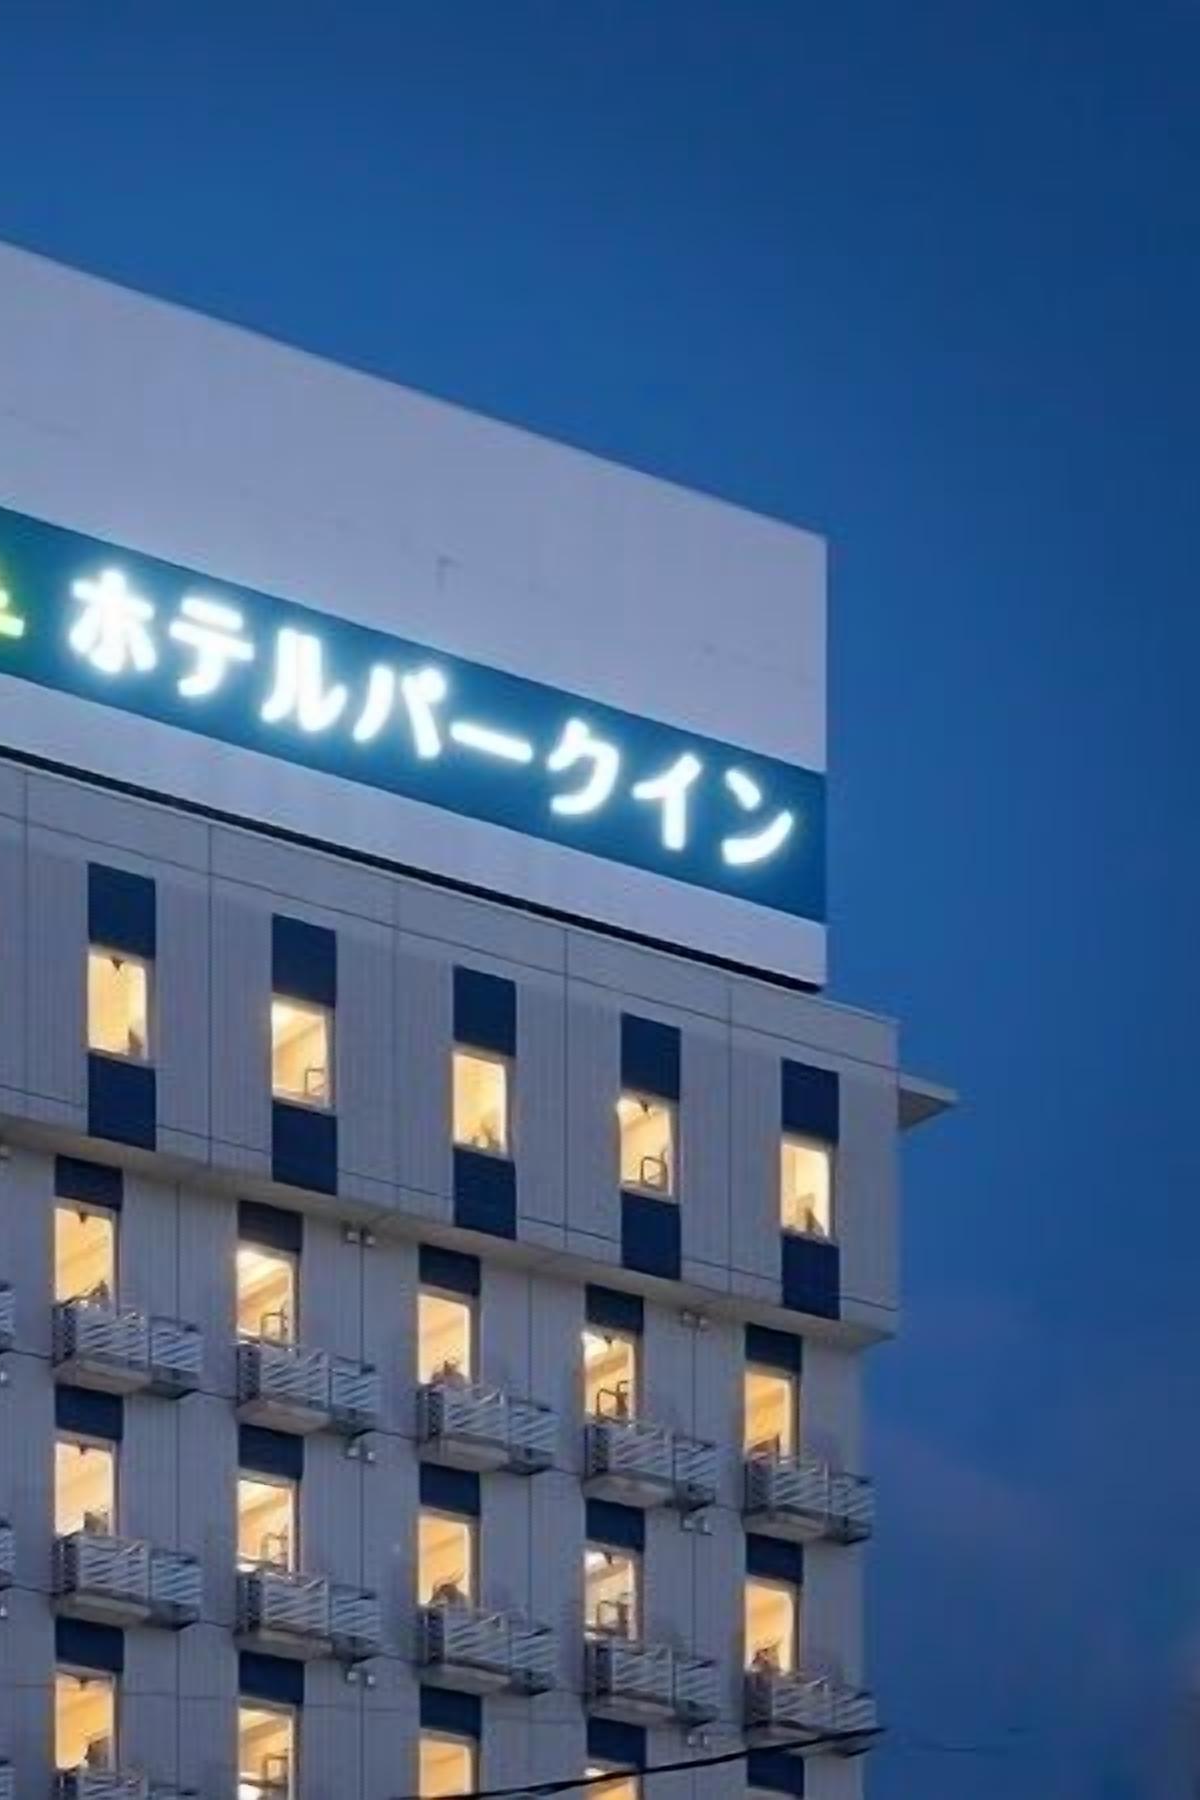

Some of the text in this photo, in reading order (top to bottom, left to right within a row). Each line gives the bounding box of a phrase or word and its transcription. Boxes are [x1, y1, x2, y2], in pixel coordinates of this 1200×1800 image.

[70, 568, 795, 866] ホテルパークイン
